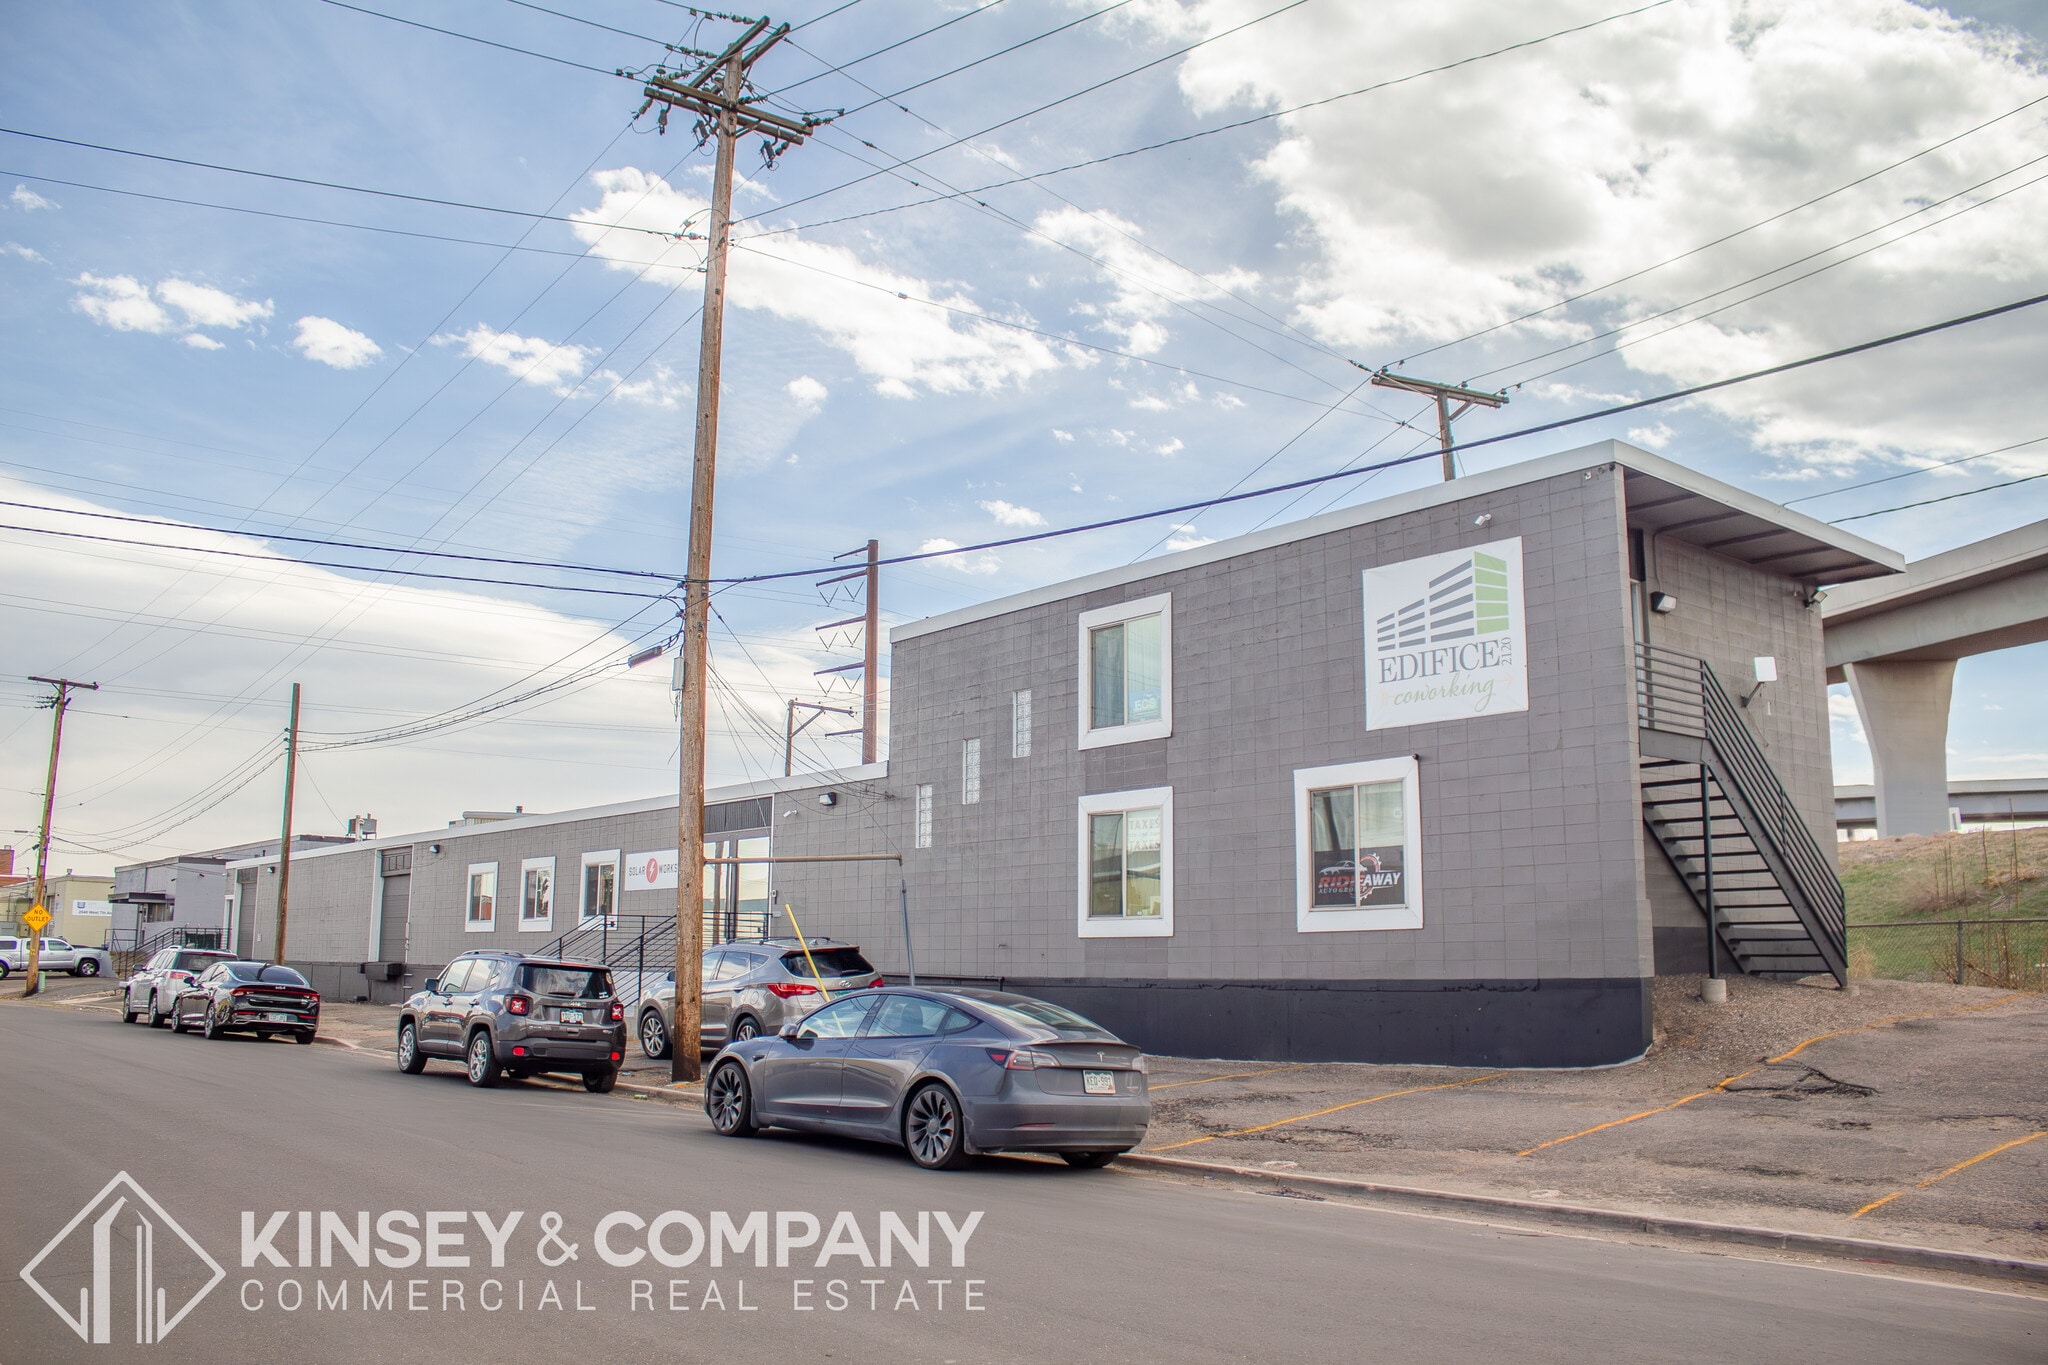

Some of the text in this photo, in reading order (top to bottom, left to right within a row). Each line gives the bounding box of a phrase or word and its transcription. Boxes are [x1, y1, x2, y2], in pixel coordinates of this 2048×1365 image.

[1378, 640, 1501, 684] EDIFICE
[1501, 637, 1512, 666] 2120
[1393, 672, 1496, 713] coworking
[1128, 818, 1160, 830] TAXES
[1128, 839, 1160, 850] TAXES
[628, 863, 678, 877] SOLAR WORKS
